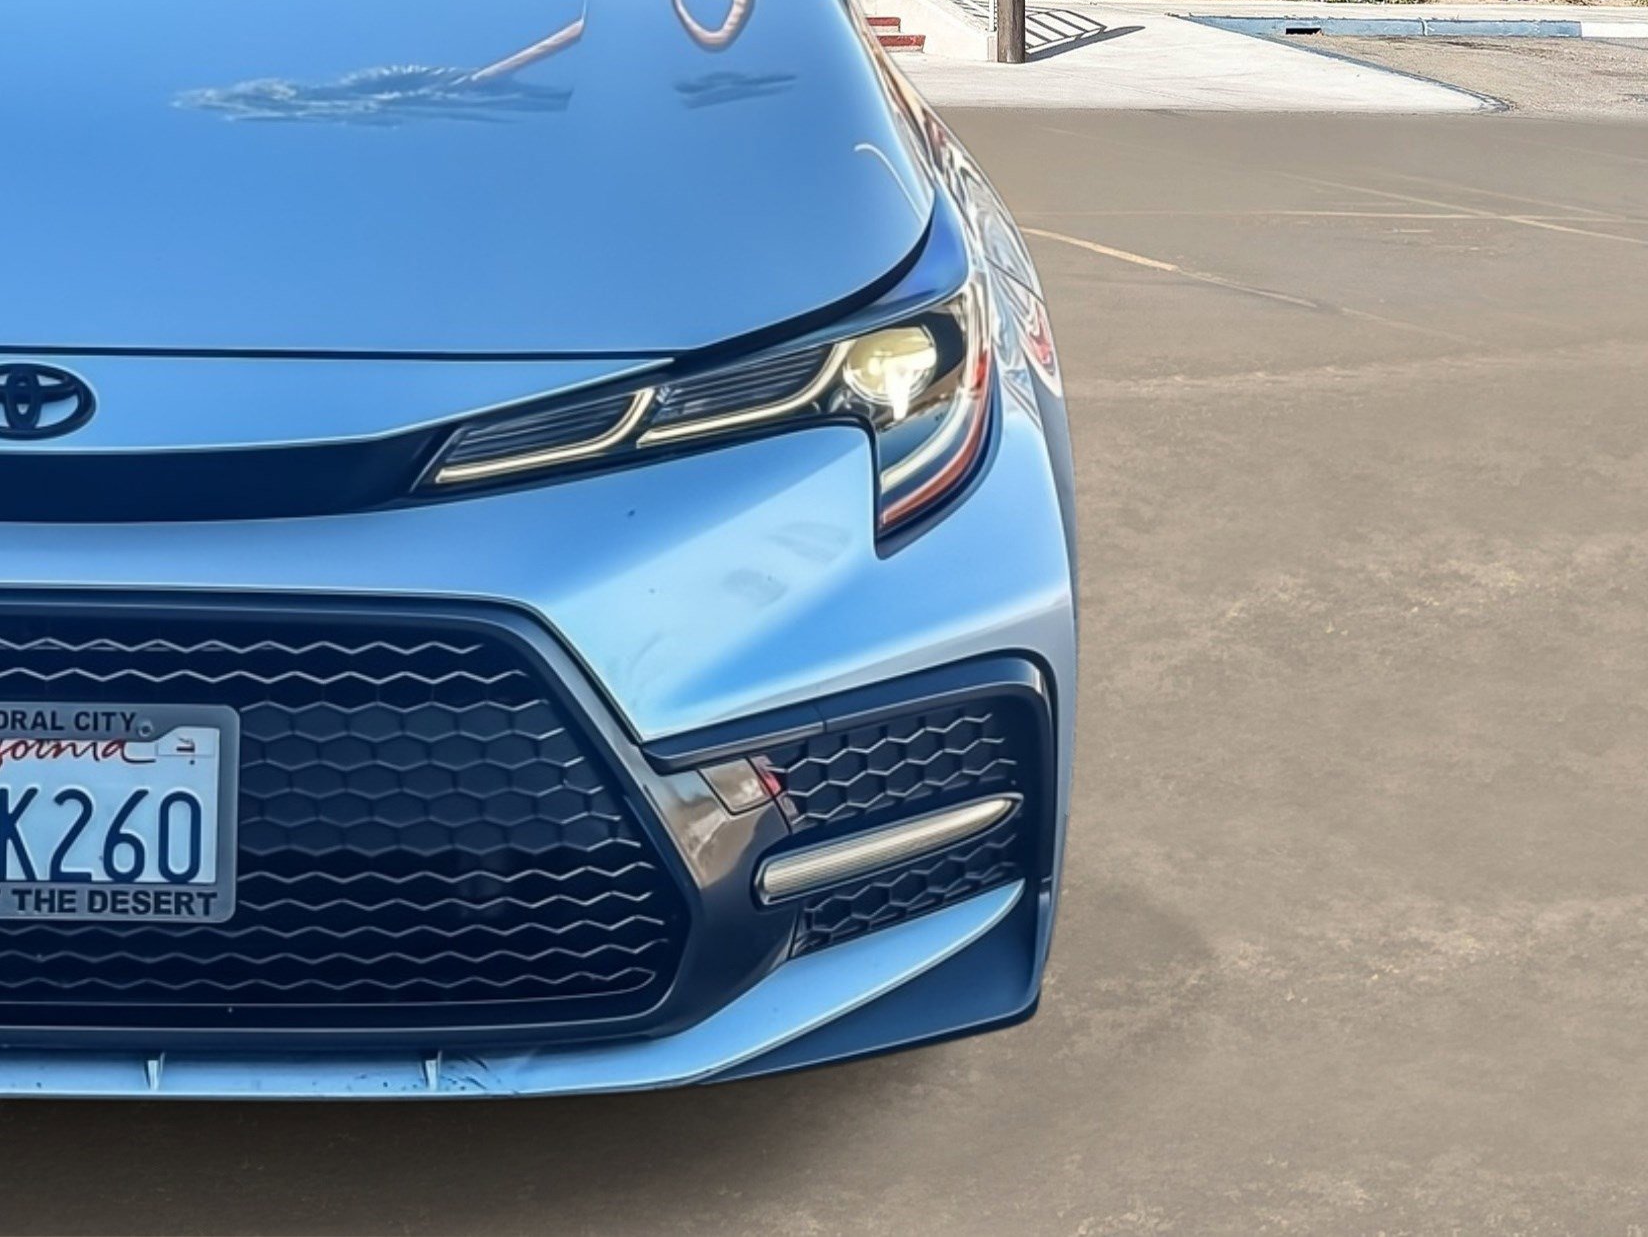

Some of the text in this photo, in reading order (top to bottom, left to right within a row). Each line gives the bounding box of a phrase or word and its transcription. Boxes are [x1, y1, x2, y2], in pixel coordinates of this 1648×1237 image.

[74, 711, 138, 733] CITY
[12, 889, 77, 914] THE
[87, 890, 218, 917] DESERT
